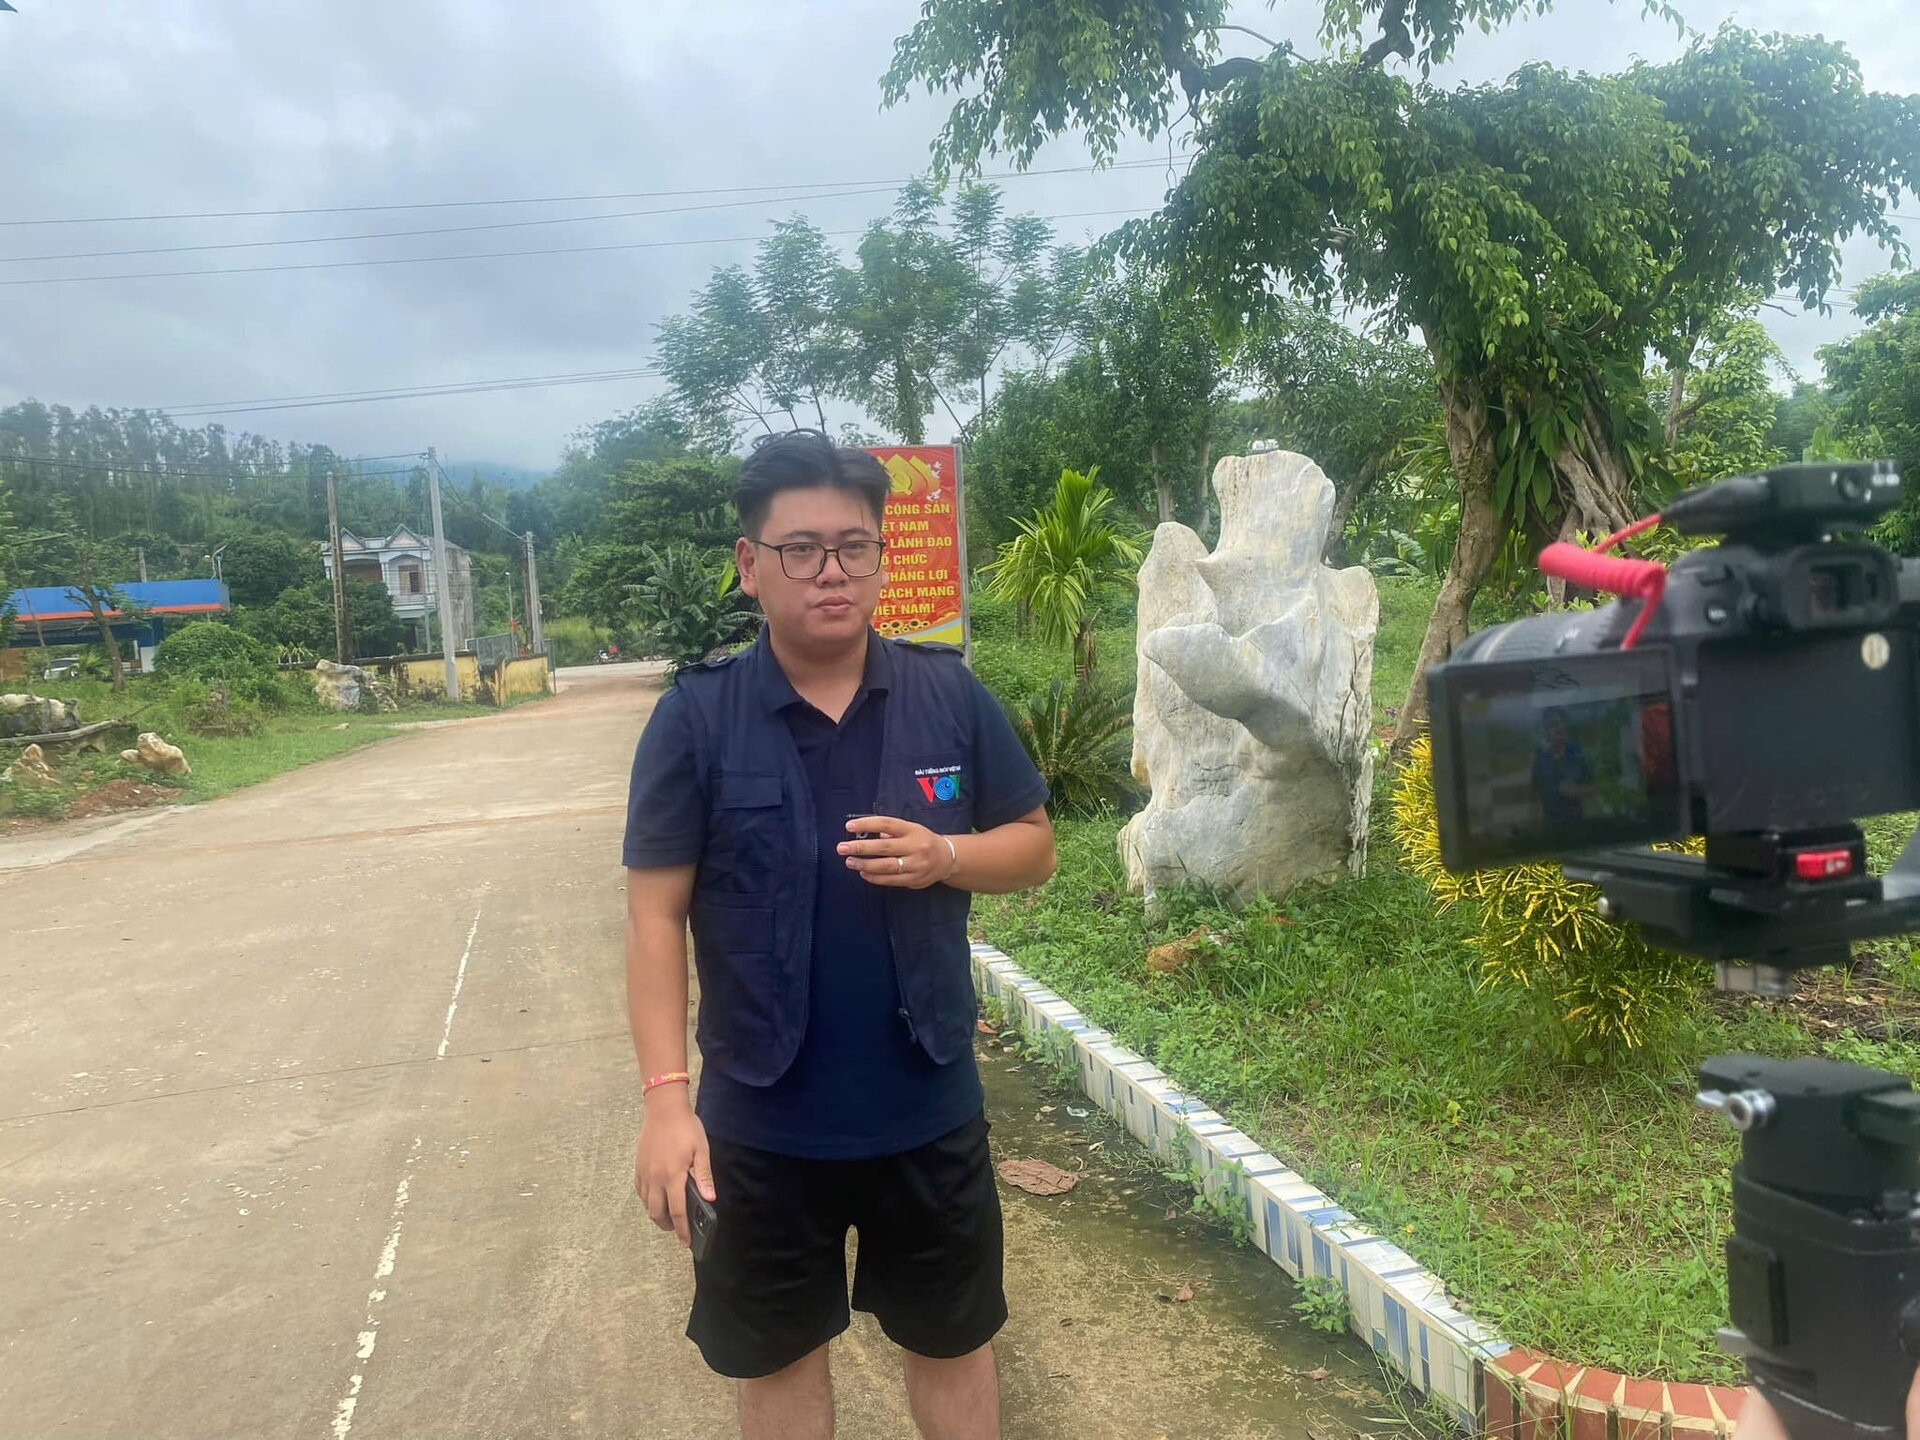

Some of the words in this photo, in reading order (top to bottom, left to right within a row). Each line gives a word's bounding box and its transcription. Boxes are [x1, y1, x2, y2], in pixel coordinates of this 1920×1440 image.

[885, 503, 920, 517] CỘNG
[924, 501, 950, 514] SẢN
[881, 520, 895, 535] ỆT
[900, 520, 929, 532] NAM
[890, 536, 923, 549] LÃNH
[927, 537, 952, 549] ĐẠO
[893, 552, 927, 565] CHỨC
[888, 568, 925, 582] HẮNG
[928, 569, 948, 582] LỢI
[880, 586, 913, 599] CÁCH
[917, 586, 954, 599] MẠNG
[901, 602, 935, 615] NAM!
